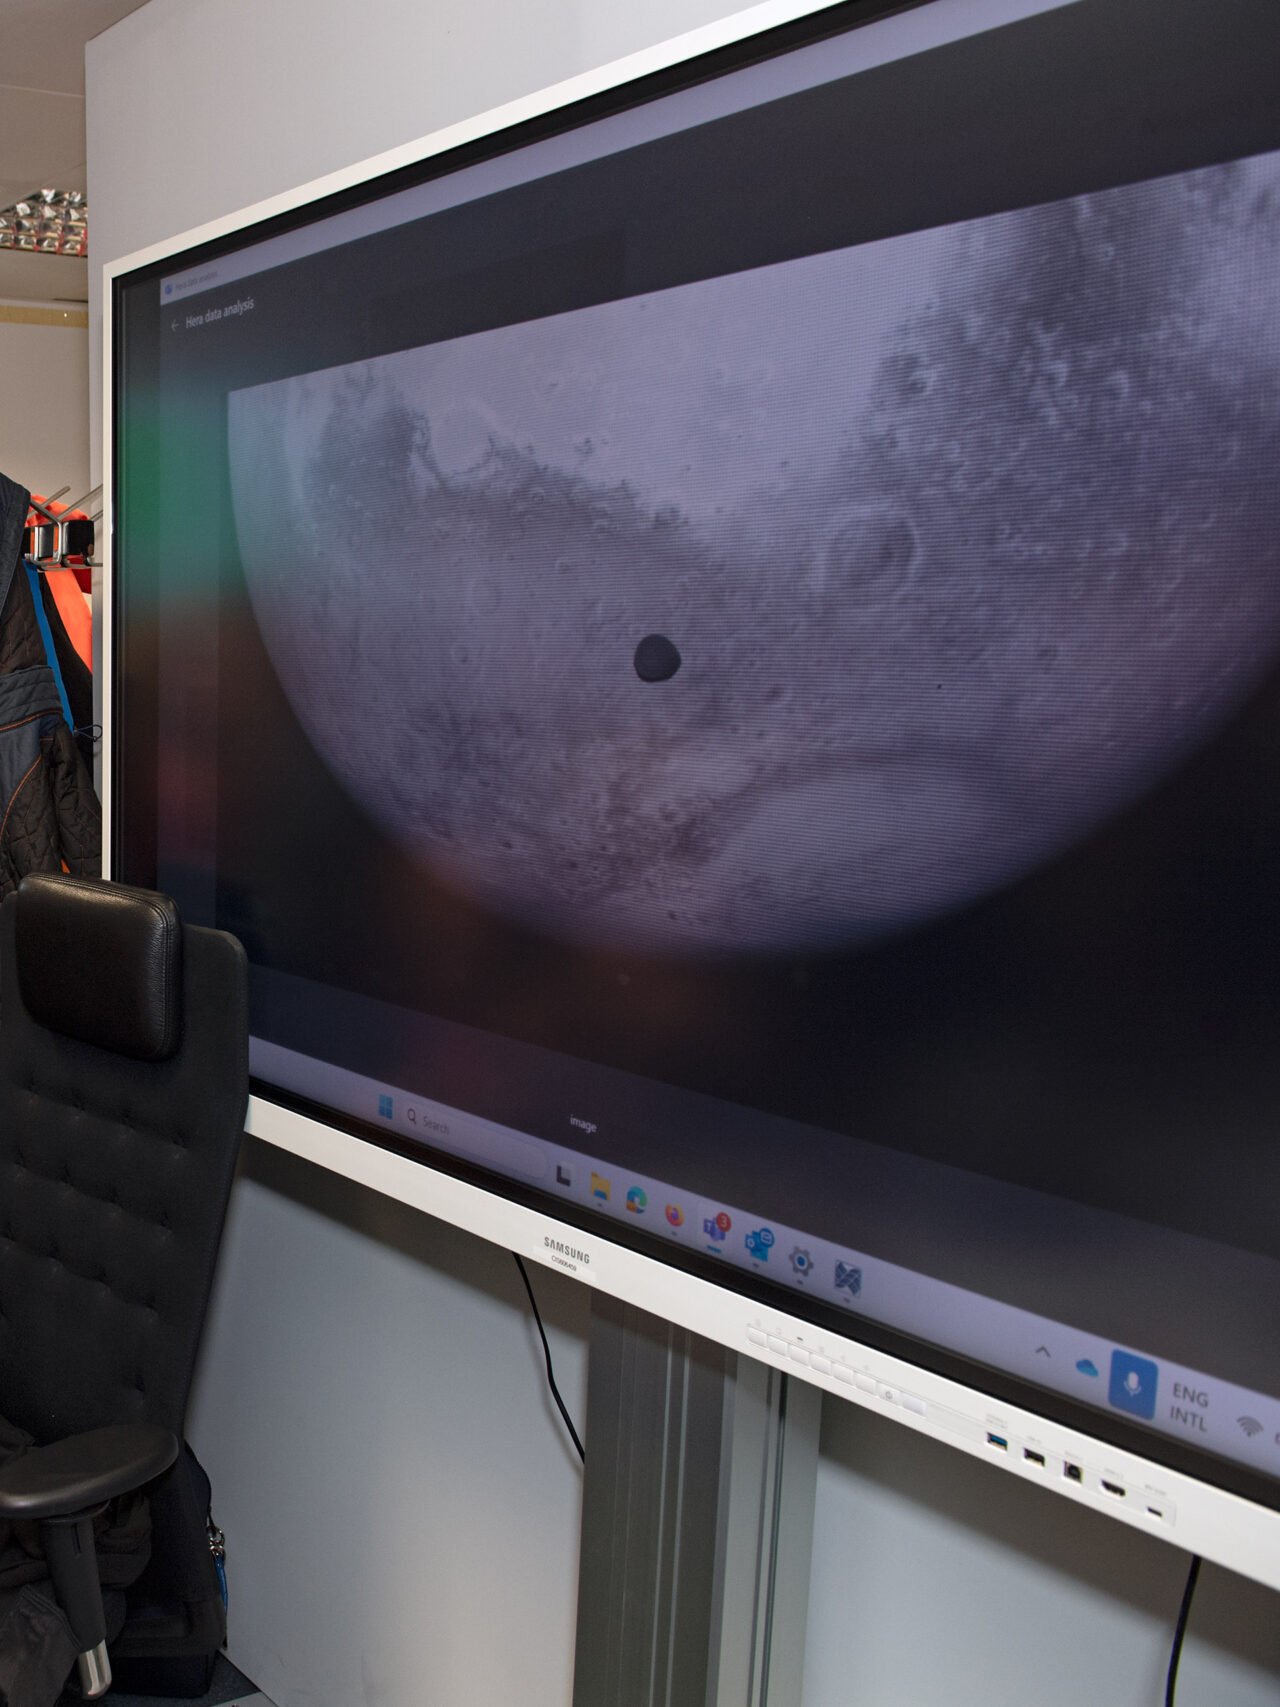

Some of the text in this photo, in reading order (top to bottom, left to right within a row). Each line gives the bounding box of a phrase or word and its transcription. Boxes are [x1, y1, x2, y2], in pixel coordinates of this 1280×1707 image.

[186, 296, 255, 329] Hera data analysis
[423, 1115, 450, 1135] Search
[570, 1114, 597, 1133] image
[544, 1236, 590, 1264] SAMSUNG
[1173, 1382, 1210, 1408] ENG
[1170, 1406, 1208, 1432] INTL
